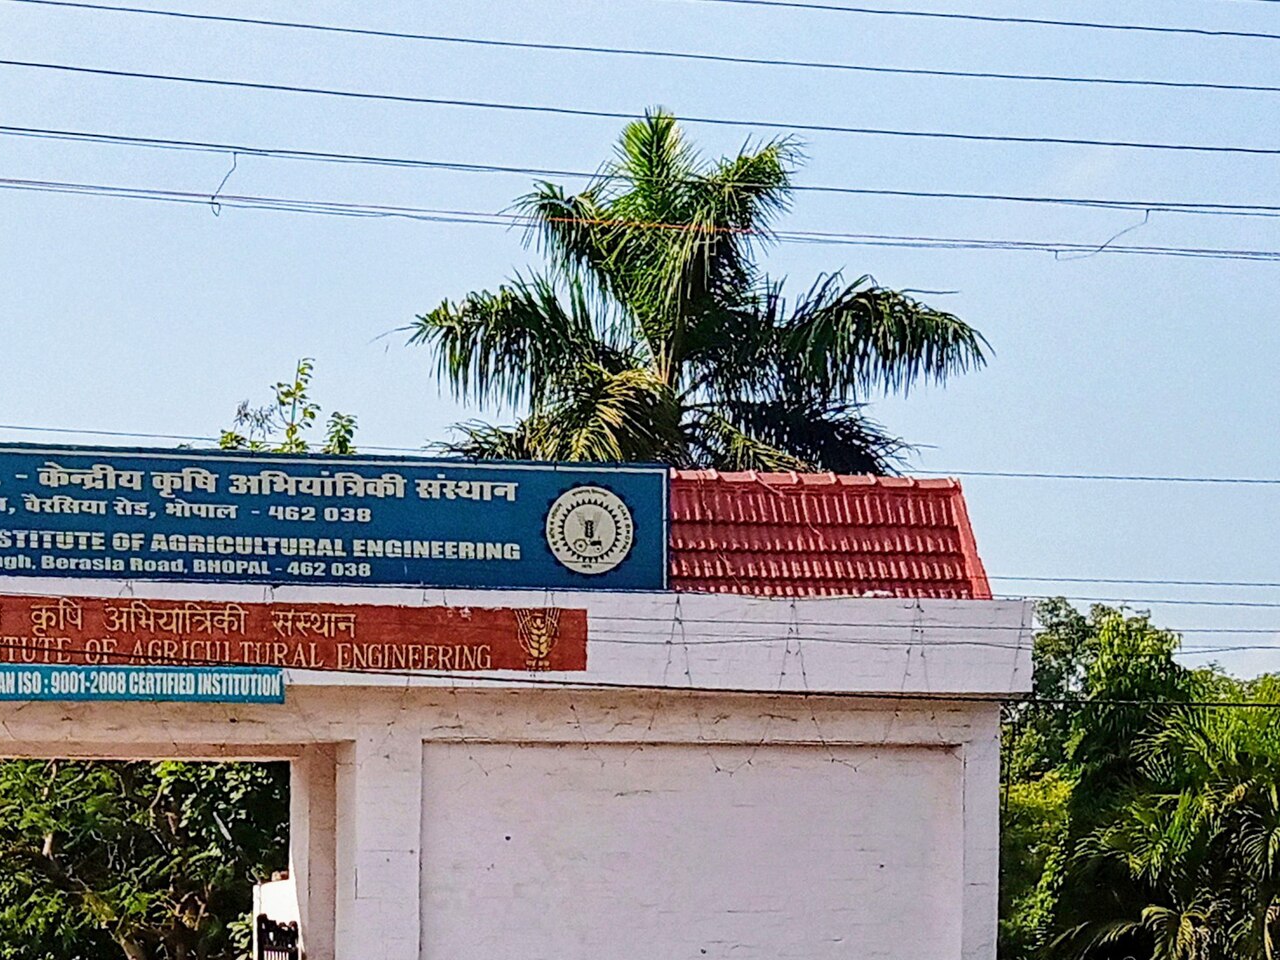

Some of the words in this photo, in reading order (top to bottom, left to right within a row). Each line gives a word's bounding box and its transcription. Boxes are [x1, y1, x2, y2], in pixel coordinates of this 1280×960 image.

[37, 461, 145, 490] केन्द्रीय
[150, 466, 219, 498] कृषि
[228, 470, 407, 498] अभियांत्रिकी
[415, 474, 518, 501] संस्थान
[165, 498, 238, 519] भोपाल
[268, 506, 316, 521] 462
[324, 507, 372, 523] 038
[112, 532, 145, 551] OF
[150, 533, 346, 558] AGRICULTURAL
[353, 539, 520, 561] ENGINEERING
[42, 555, 124, 572] Berasia
[130, 557, 189, 574] Road,
[193, 559, 271, 575] BHOPAL
[287, 562, 326, 577] 462
[332, 563, 371, 577] 038
[30, 598, 83, 636] कृषि
[85, 637, 119, 664] OF
[129, 639, 325, 669] AGRICULTURAL
[335, 642, 492, 670] ENGINEERING
[50, 671, 126, 694] 9001-2008
[129, 671, 195, 695] CERTIFIED
[198, 673, 281, 696] INSTITUTION
